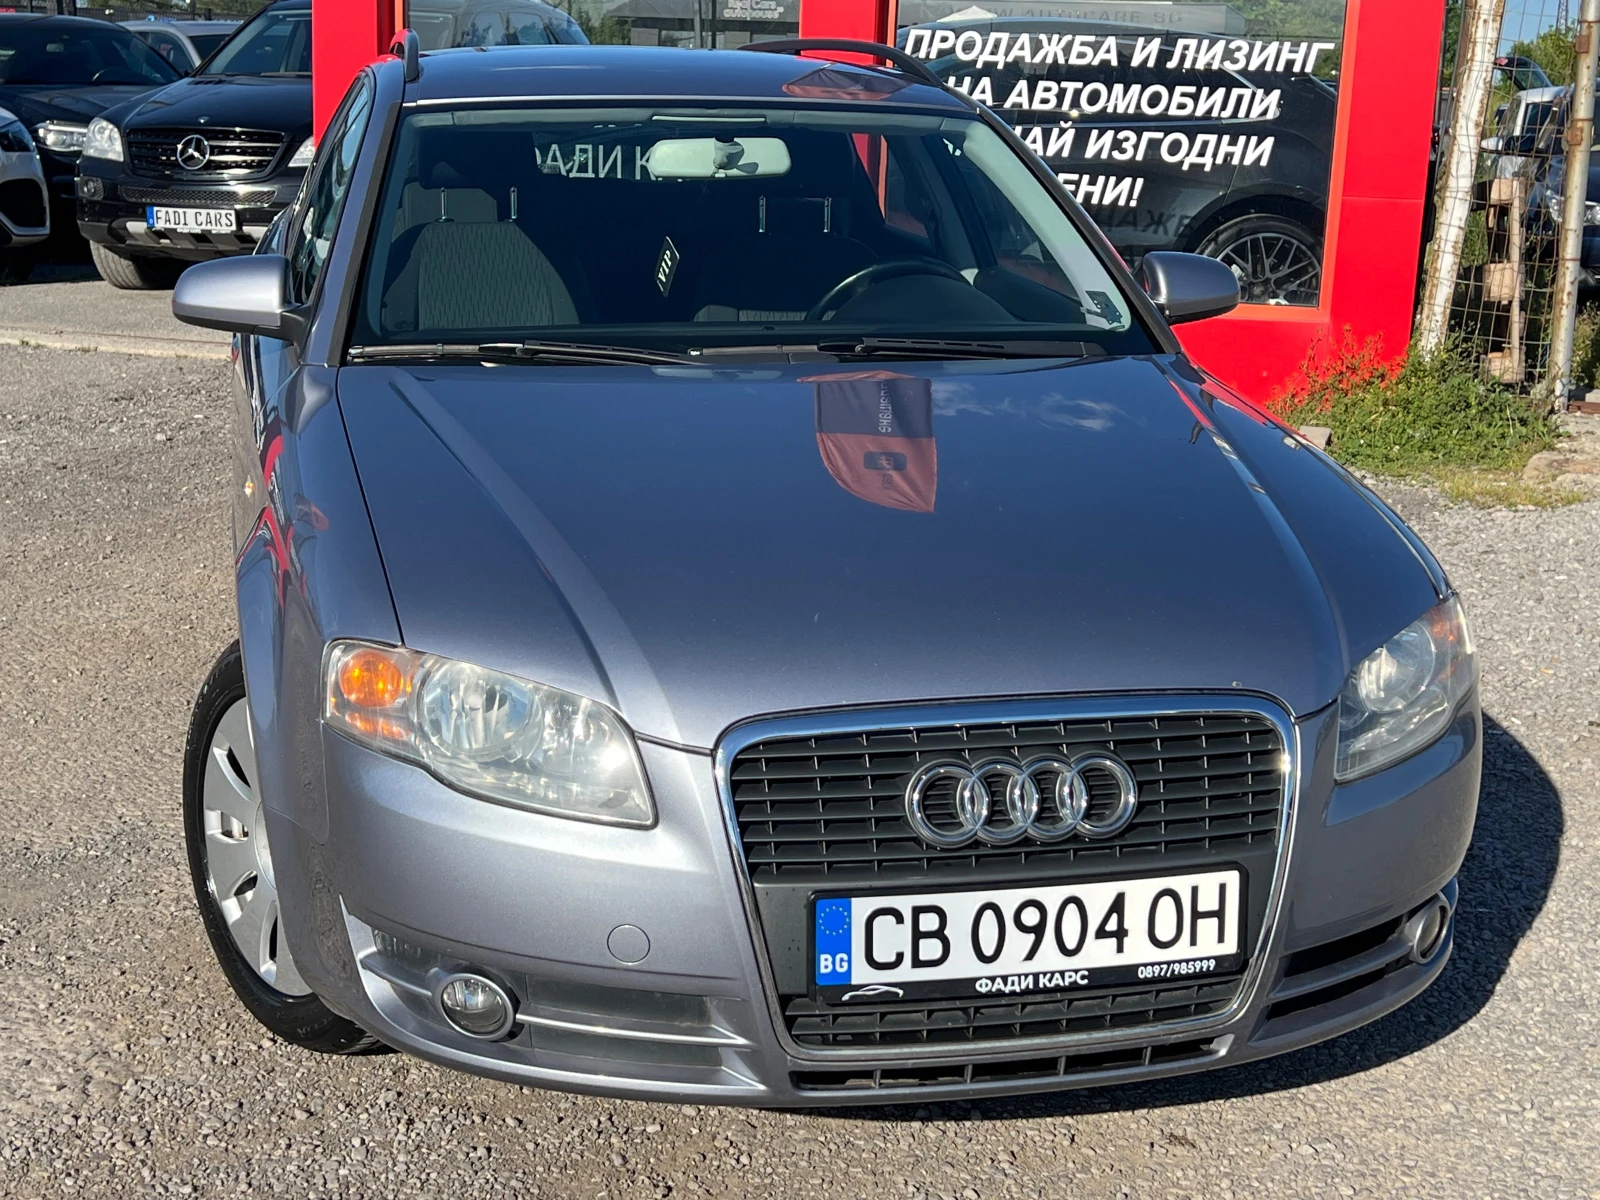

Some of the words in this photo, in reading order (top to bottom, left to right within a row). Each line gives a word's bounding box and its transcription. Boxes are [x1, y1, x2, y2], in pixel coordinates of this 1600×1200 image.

[904, 28, 1118, 69] ПРОДАЖБА
[1130, 37, 1159, 68] И
[1166, 37, 1336, 74] ЛИЗИНГ
[947, 75, 993, 106] НА
[1003, 80, 1282, 119] АВТОМОБИЛИ
[535, 144, 622, 178] АДИ
[1014, 121, 1076, 158] АЙ
[1084, 129, 1275, 171] ИЗГОДНИ
[1056, 173, 1143, 208] ЕНИ!
[155, 210, 189, 226] FADI
[194, 211, 233, 227] CARS
[657, 249, 672, 283] VIP
[864, 905, 951, 971] CB
[970, 891, 1128, 964] 0904
[1147, 882, 1227, 950] OH
[819, 952, 849, 974] BG
[1137, 958, 1216, 980] 0897/985999
[975, 973, 1035, 994] ФАДИ
[1038, 969, 1090, 989] КАРС
